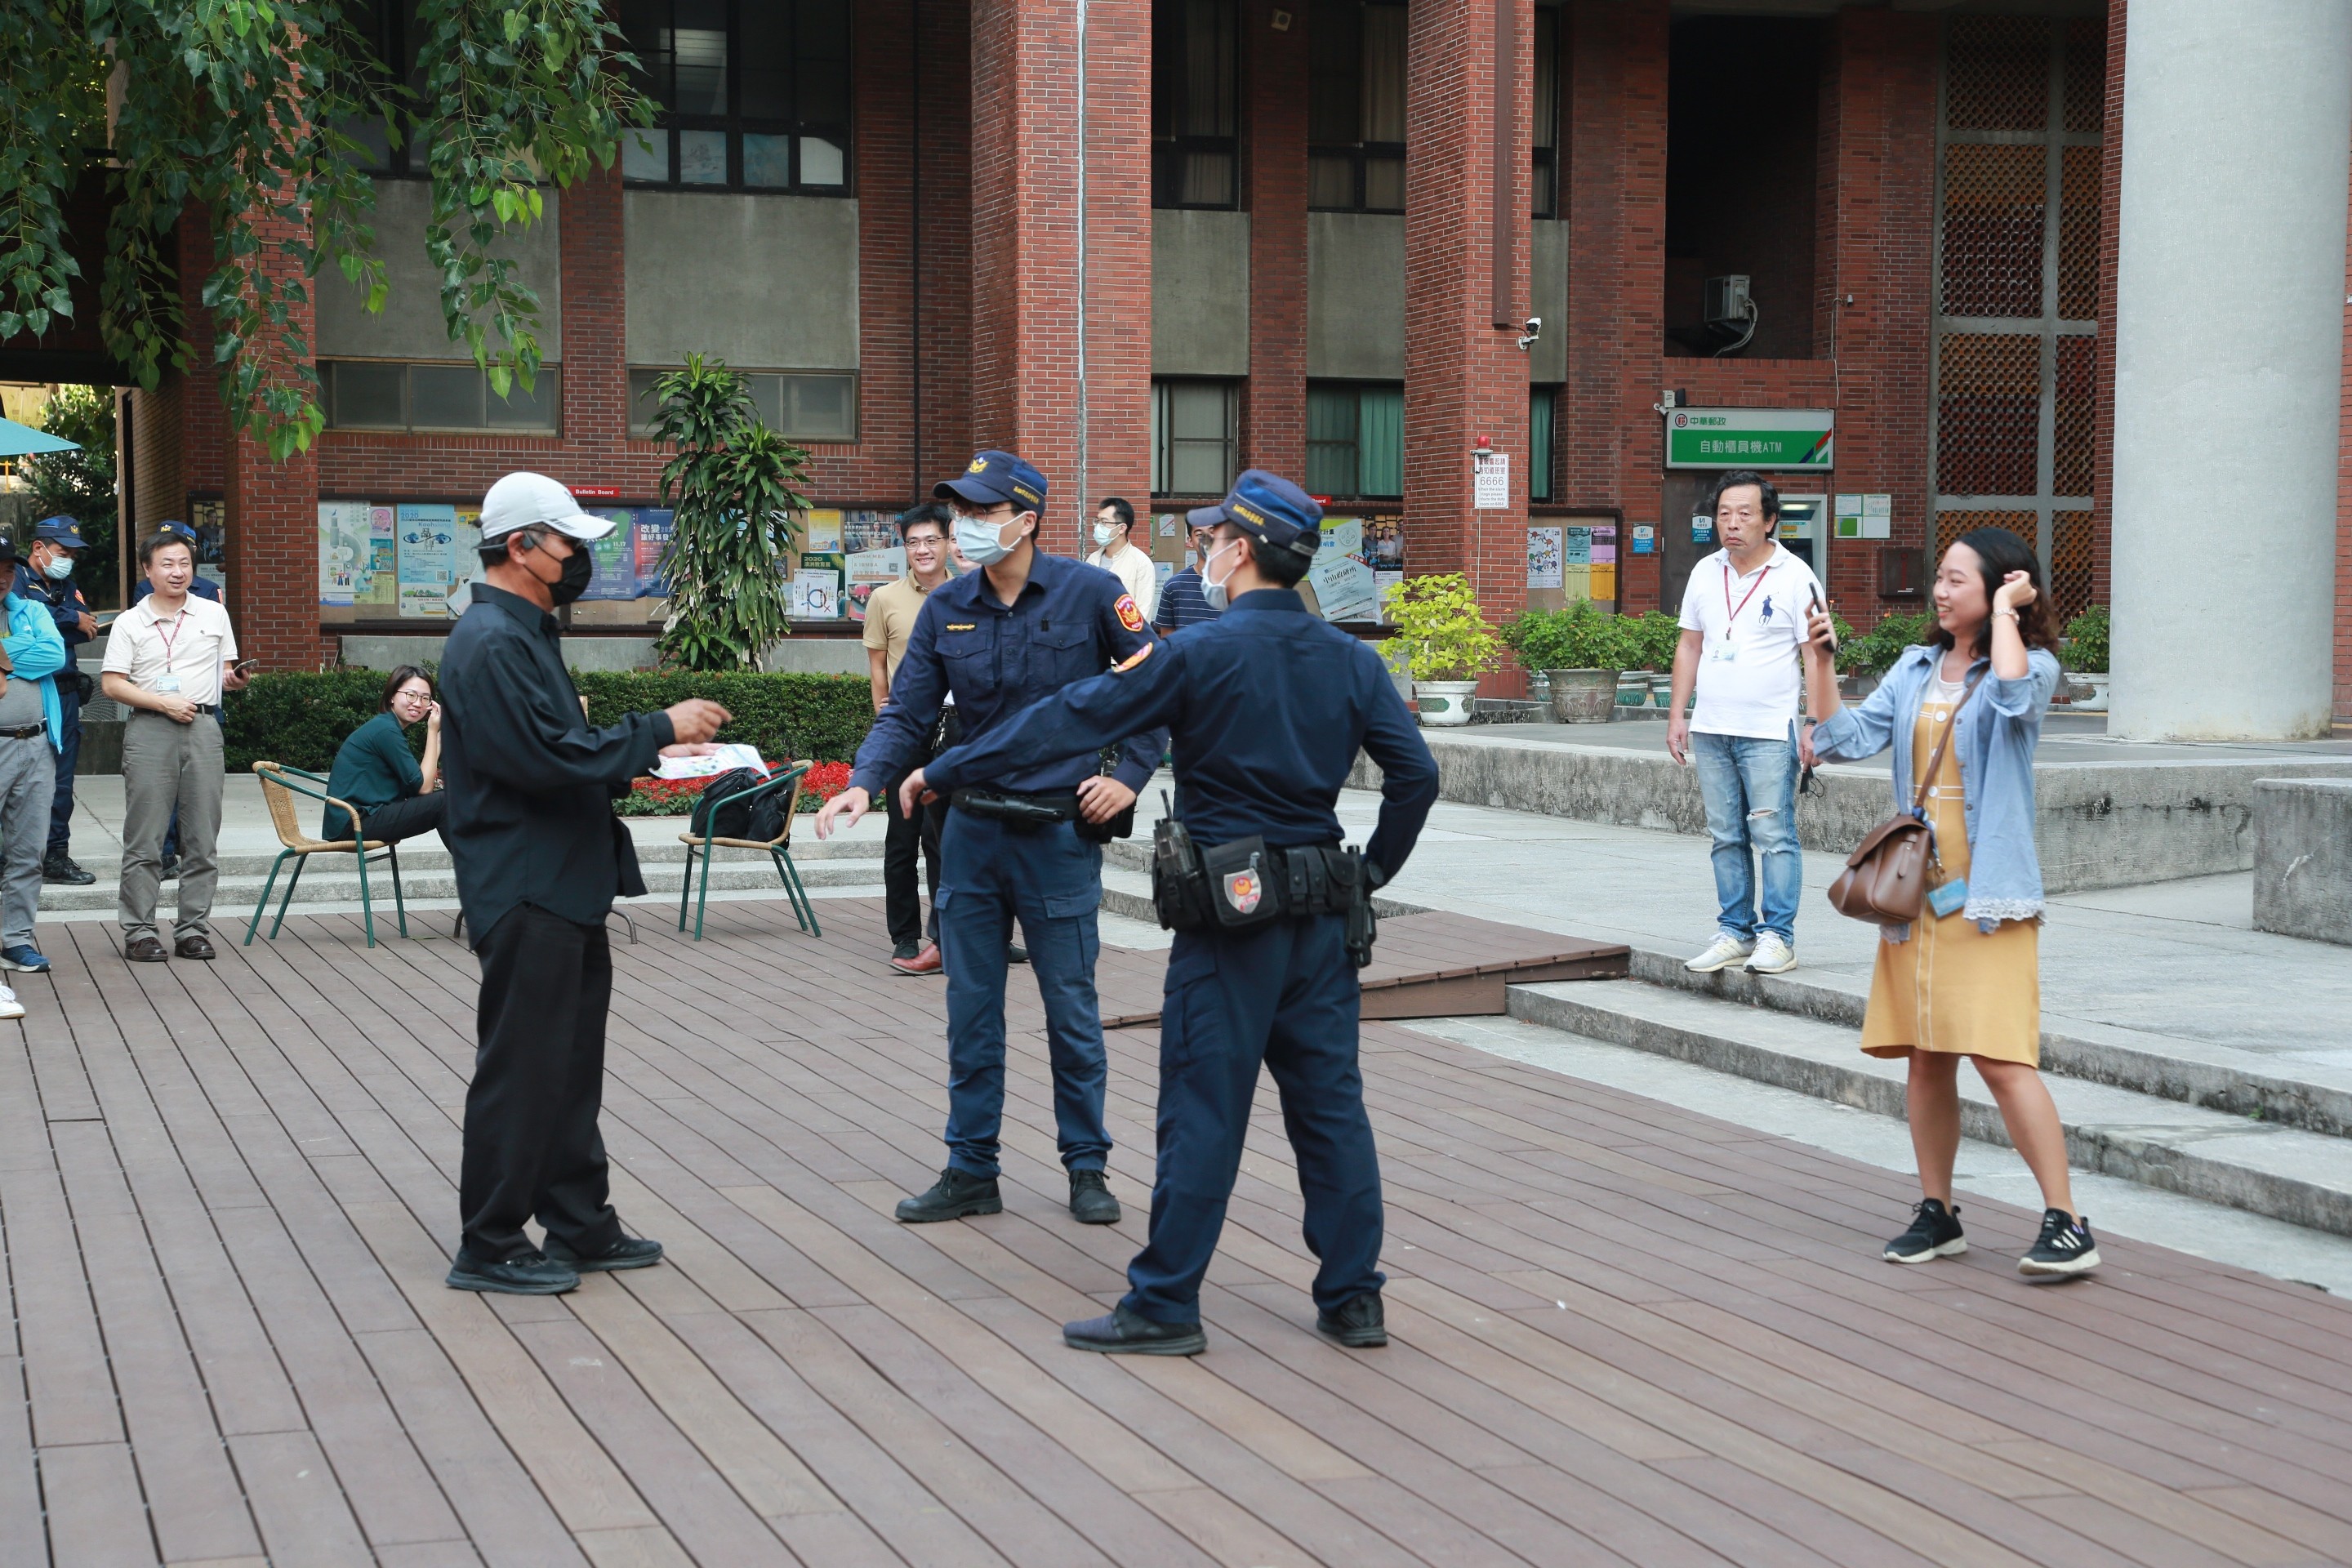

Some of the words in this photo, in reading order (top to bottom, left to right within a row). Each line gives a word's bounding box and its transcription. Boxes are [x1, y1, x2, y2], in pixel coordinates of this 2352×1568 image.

[1690, 416, 1726, 425] 中華郵政
[1700, 439, 1782, 453] 自動櫃員機ATM
[1481, 477, 1503, 485] 6666
[640, 523, 661, 533] 改變
